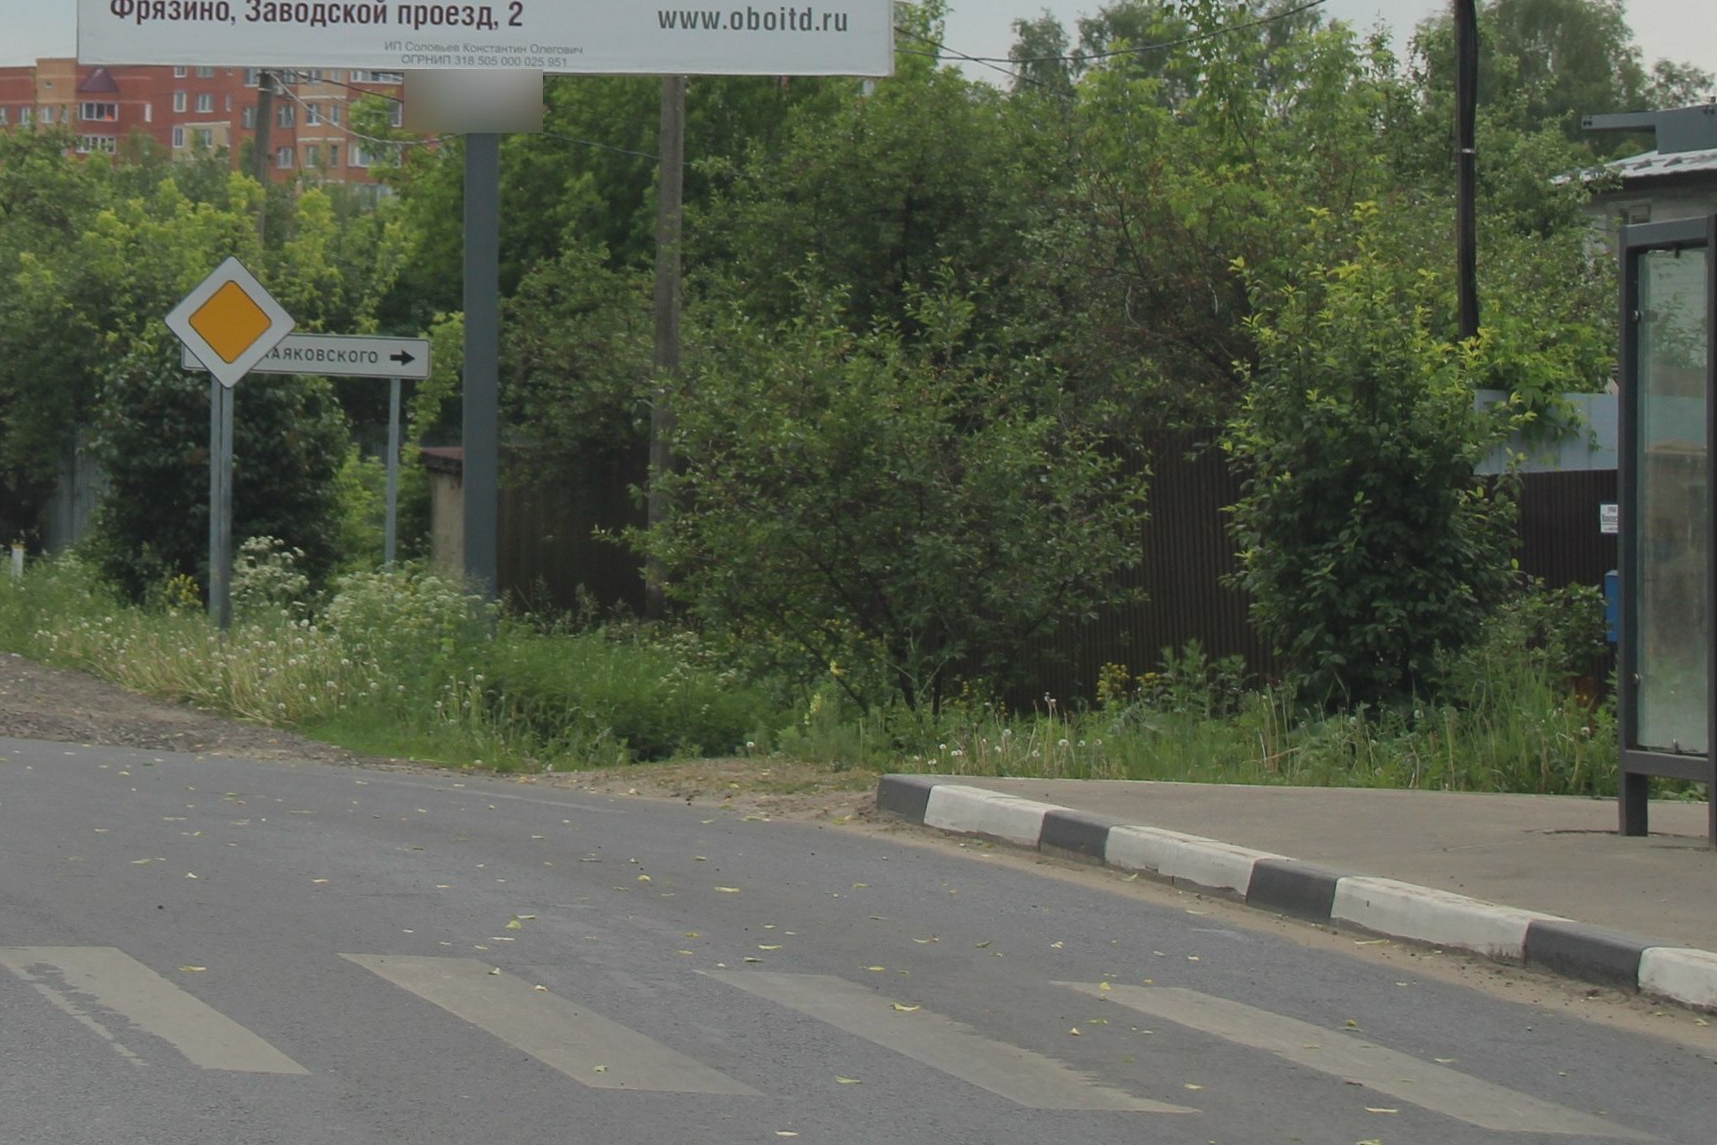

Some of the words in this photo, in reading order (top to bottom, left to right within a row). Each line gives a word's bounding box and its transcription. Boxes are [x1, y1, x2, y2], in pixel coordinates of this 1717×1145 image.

[398, 4, 499, 30] проезд,
[507, 1, 524, 27] 2
[658, 7, 848, 32] www.oboitd.ru
[384, 41, 402, 51] ИП
[462, 42, 527, 54] Константин
[530, 43, 584, 55] Олегович
[401, 54, 451, 66] ОГРНИП
[454, 55, 475, 66] 318
[478, 56, 498, 67] 505
[501, 56, 521, 67] 000
[524, 57, 545, 67] 025
[547, 58, 568, 68] 951
